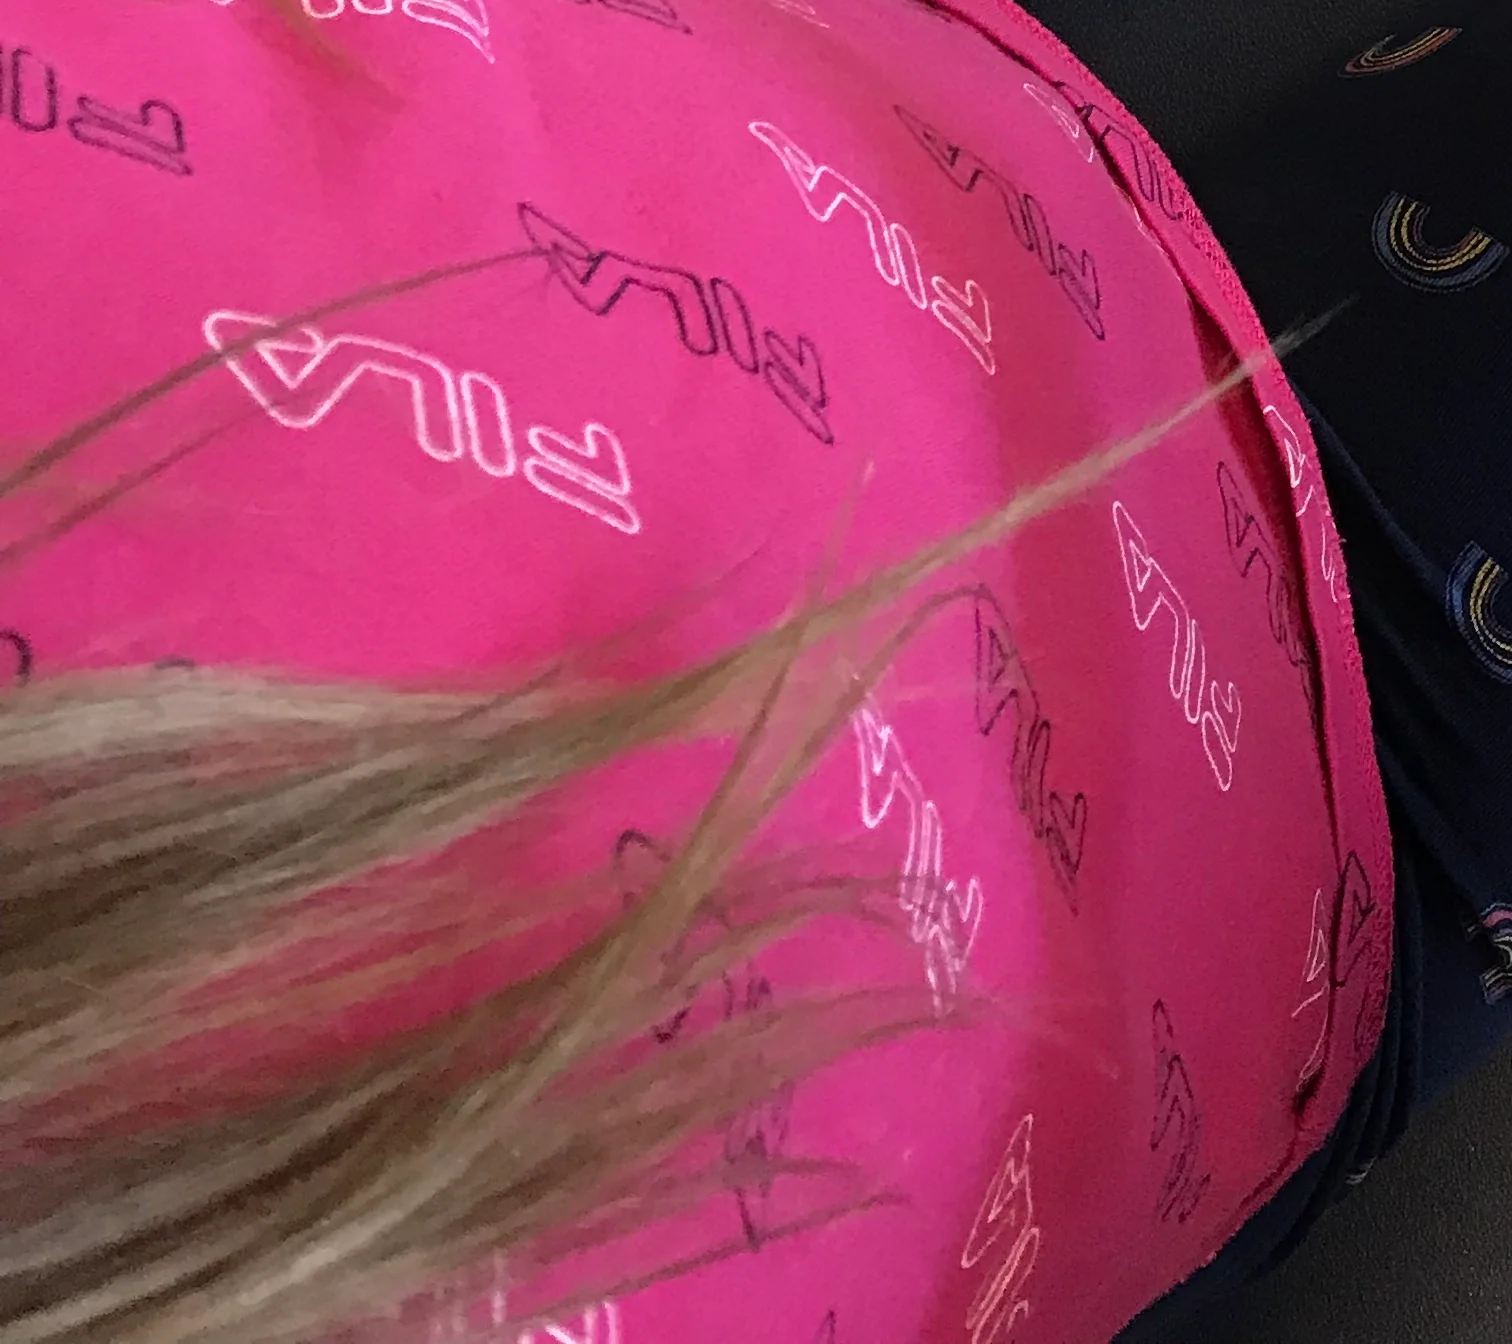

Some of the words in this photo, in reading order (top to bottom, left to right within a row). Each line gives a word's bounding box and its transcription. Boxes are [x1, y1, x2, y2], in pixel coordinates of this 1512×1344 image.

[518, 200, 835, 446] FILA
[745, 119, 996, 375] FILA
[893, 103, 1106, 341] FILA
[203, 309, 642, 535] FILA
[1112, 500, 1243, 792] FILA
